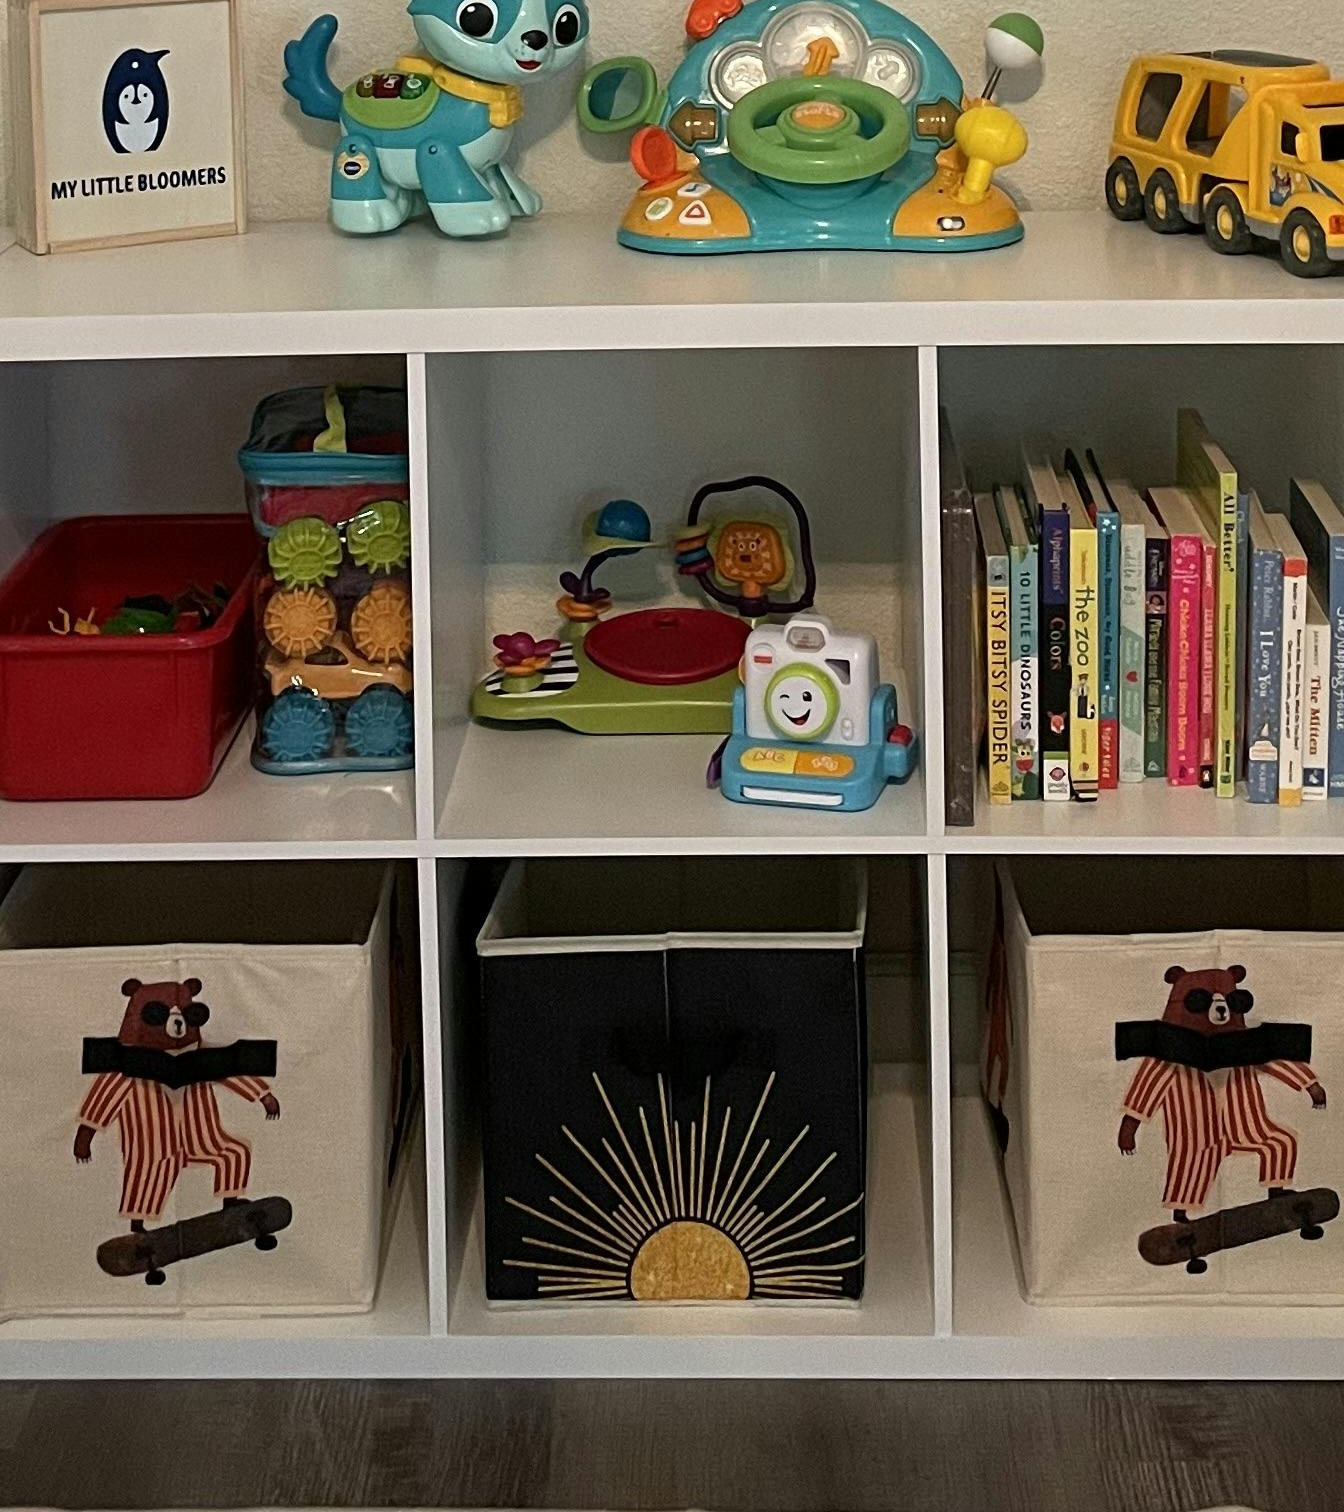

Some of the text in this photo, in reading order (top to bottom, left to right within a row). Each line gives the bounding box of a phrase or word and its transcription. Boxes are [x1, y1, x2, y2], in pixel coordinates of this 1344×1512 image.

[51, 166, 226, 200] MY LITTLE BLOOMERS
[1223, 492, 1235, 514] All
[1263, 560, 1275, 583] Peter
[1075, 585, 1095, 622] the
[1179, 599, 1190, 639] Chicka
[1020, 571, 1031, 731] 10 LITTLE DINOSAURS
[1050, 617, 1066, 670] Colors
[1075, 627, 1089, 666] zoo
[1260, 641, 1274, 671] Love
[990, 591, 1008, 765] ITSY BITSY SPIDER
[1258, 674, 1272, 697] You
[1178, 681, 1189, 715] Boom
[1309, 676, 1321, 755] The Mitten
[1101, 727, 1112, 752] tiger
[1178, 717, 1188, 751] Boom
